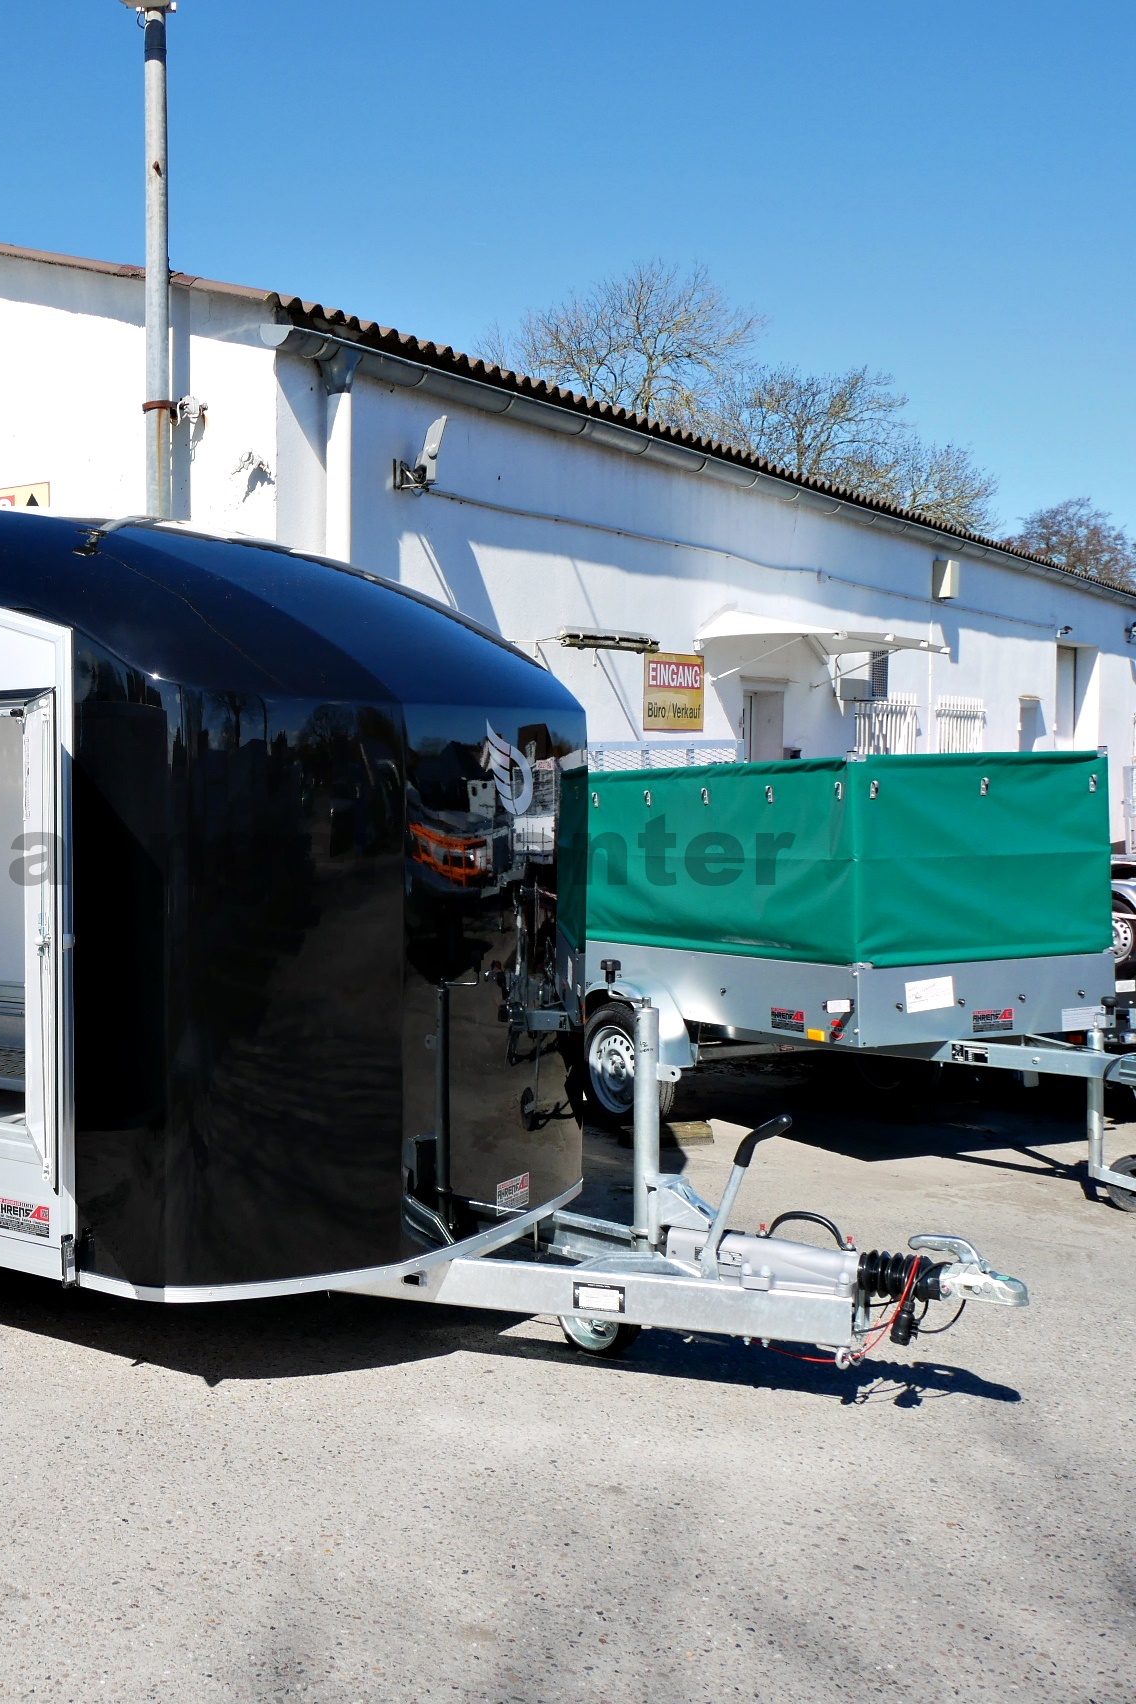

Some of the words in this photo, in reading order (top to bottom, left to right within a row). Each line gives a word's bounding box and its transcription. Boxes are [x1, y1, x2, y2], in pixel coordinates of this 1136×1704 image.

[649, 663, 700, 687] EINGANG
[647, 701, 666, 719] Büro
[672, 704, 701, 719] Verkauf
